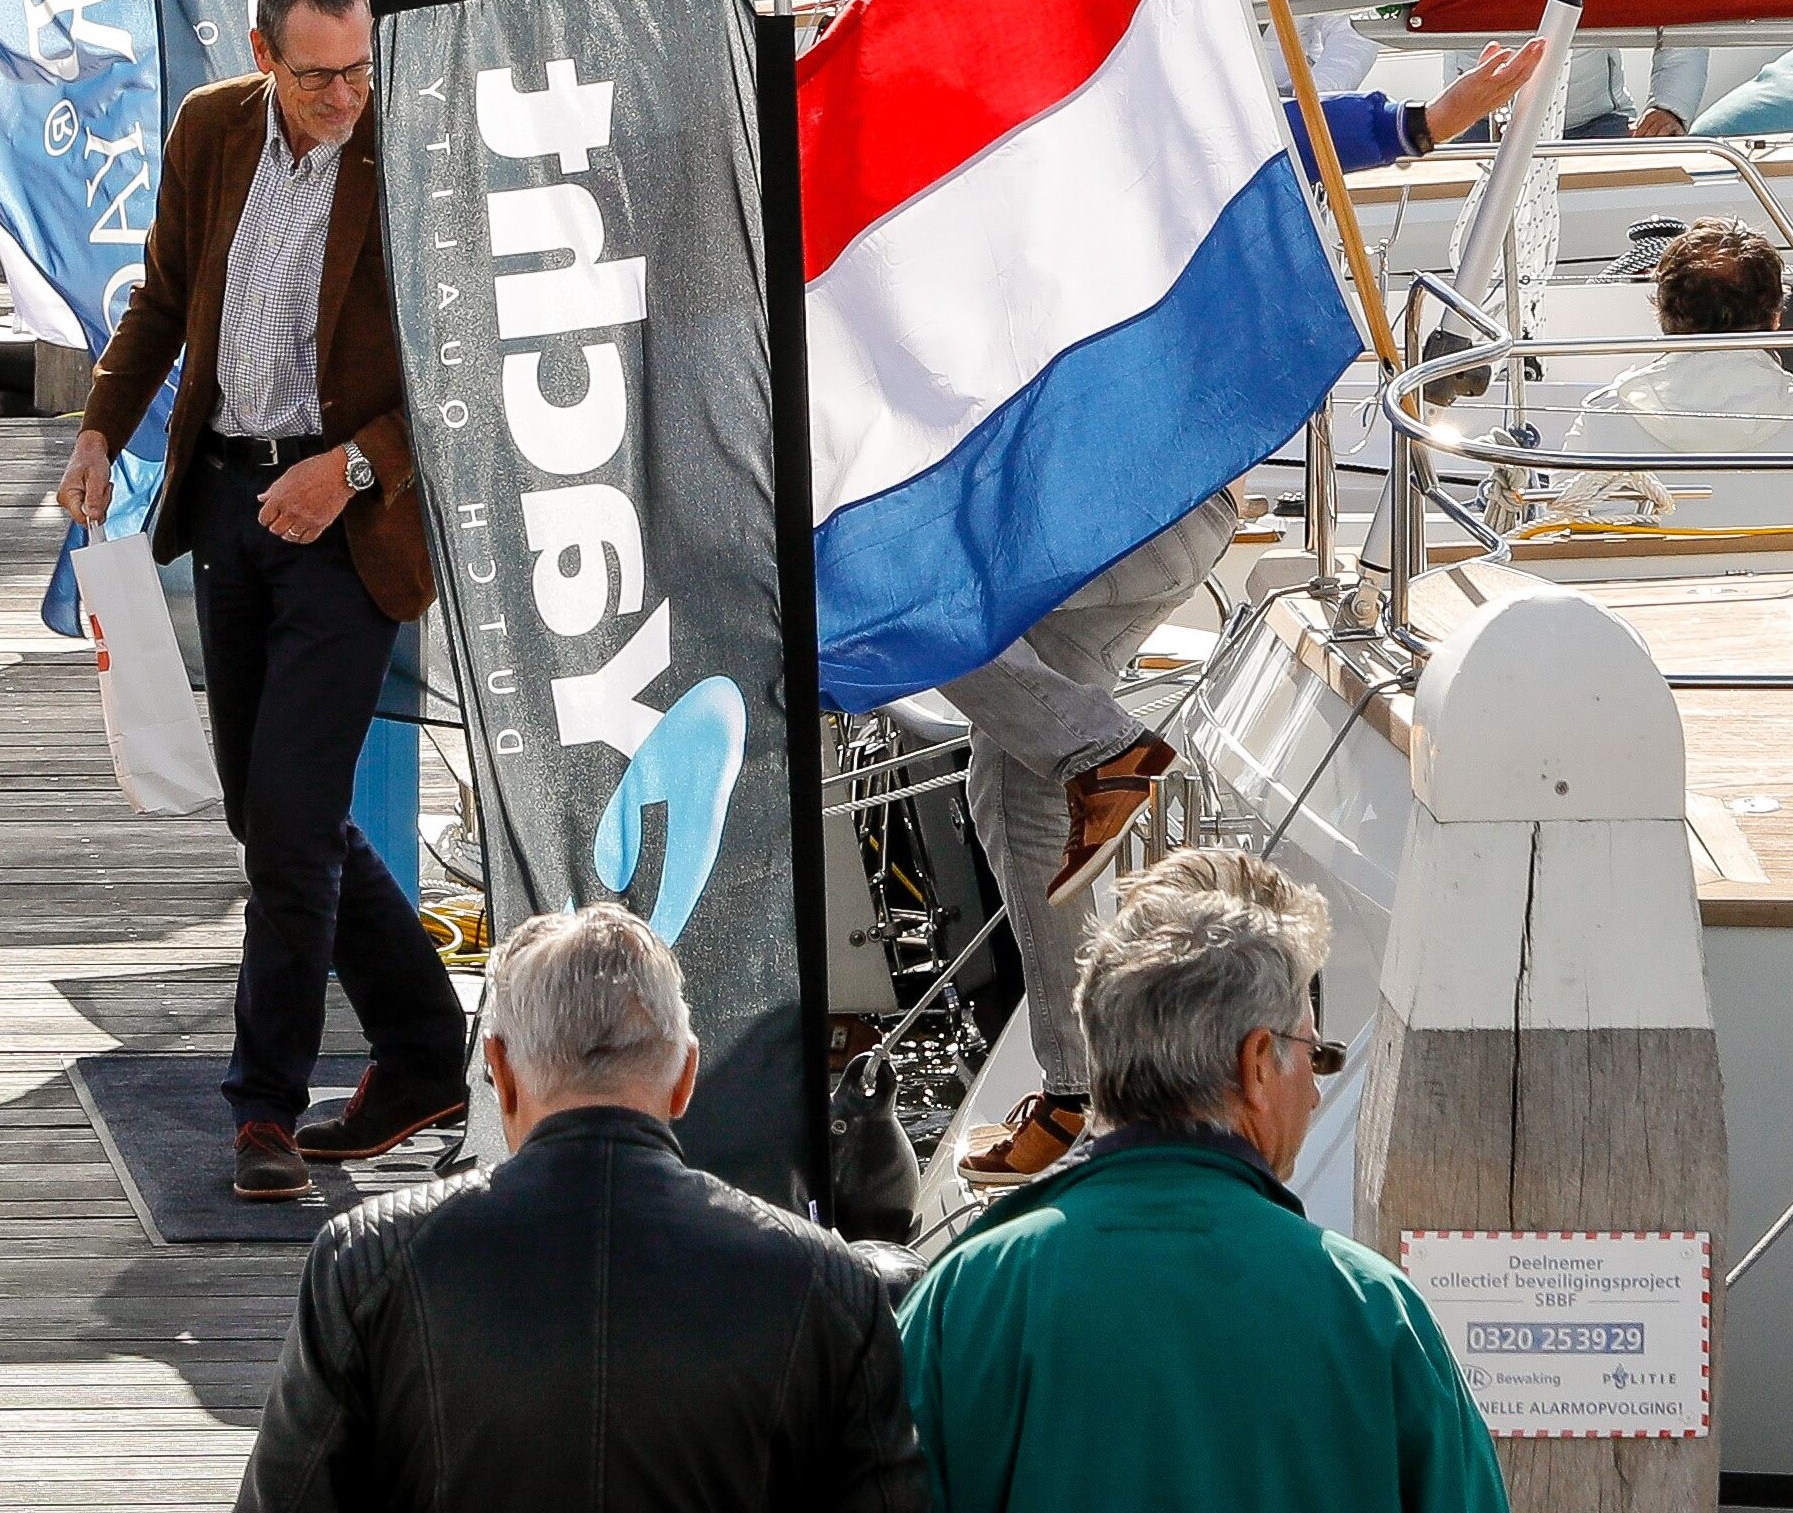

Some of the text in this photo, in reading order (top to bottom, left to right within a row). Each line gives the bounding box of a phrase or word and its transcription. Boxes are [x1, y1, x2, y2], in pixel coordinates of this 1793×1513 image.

[1508, 1255, 1604, 1270] Deelnemer
[1430, 1272, 1681, 1292] collectief beveiligingsproject
[1534, 1292, 1577, 1307] SBBF
[1468, 1326, 1534, 1351] 0320
[1496, 1371, 1562, 1387] Bewaking
[1478, 1400, 1684, 1415] NELLE ALARMOPVOLGING!
